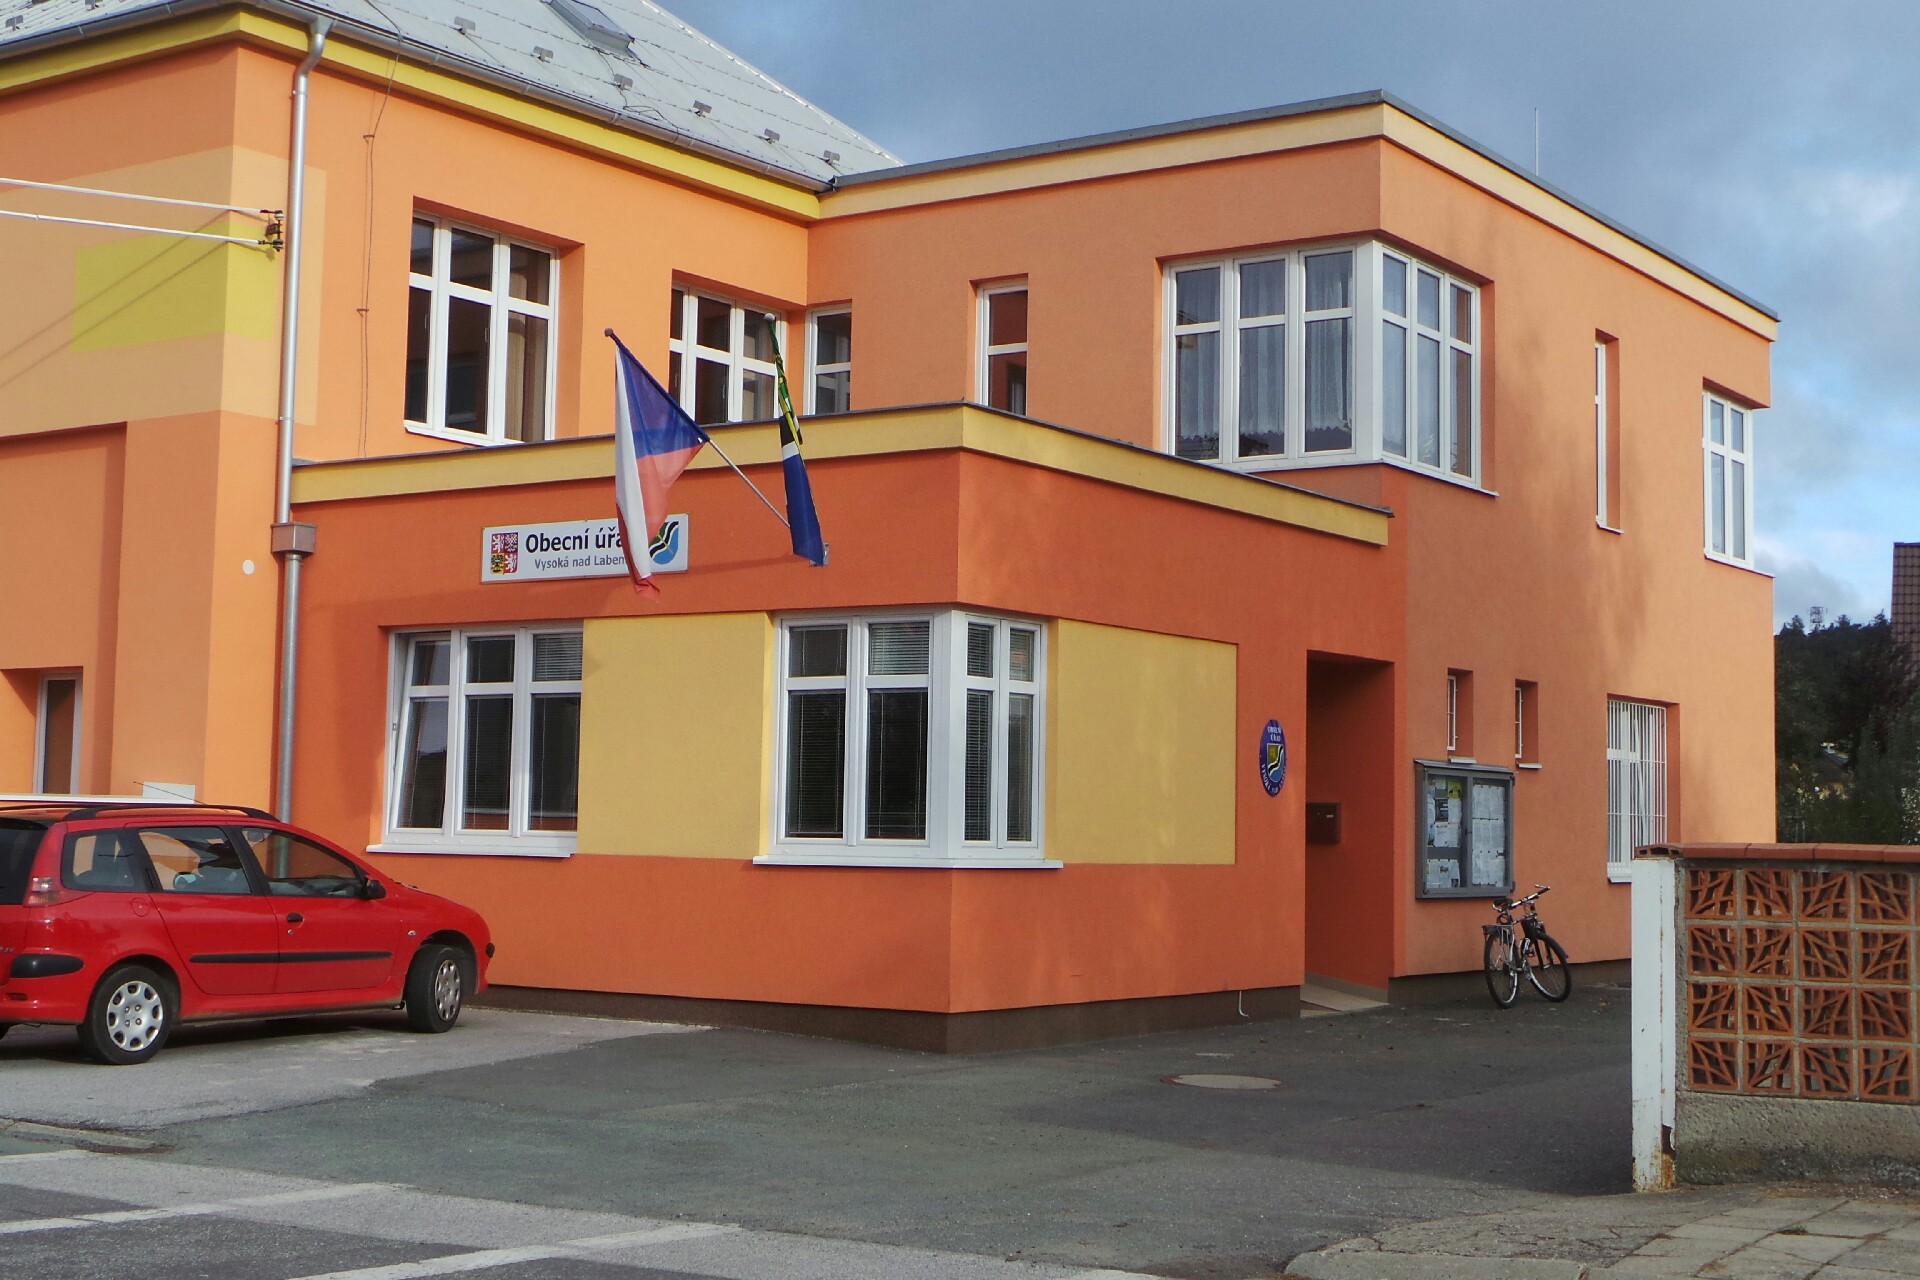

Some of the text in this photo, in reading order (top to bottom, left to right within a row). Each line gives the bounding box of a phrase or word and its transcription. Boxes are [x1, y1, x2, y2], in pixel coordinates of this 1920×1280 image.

[525, 526, 624, 553] Obecní úřa
[534, 556, 569, 571] Vysoká
[572, 555, 591, 567] nad
